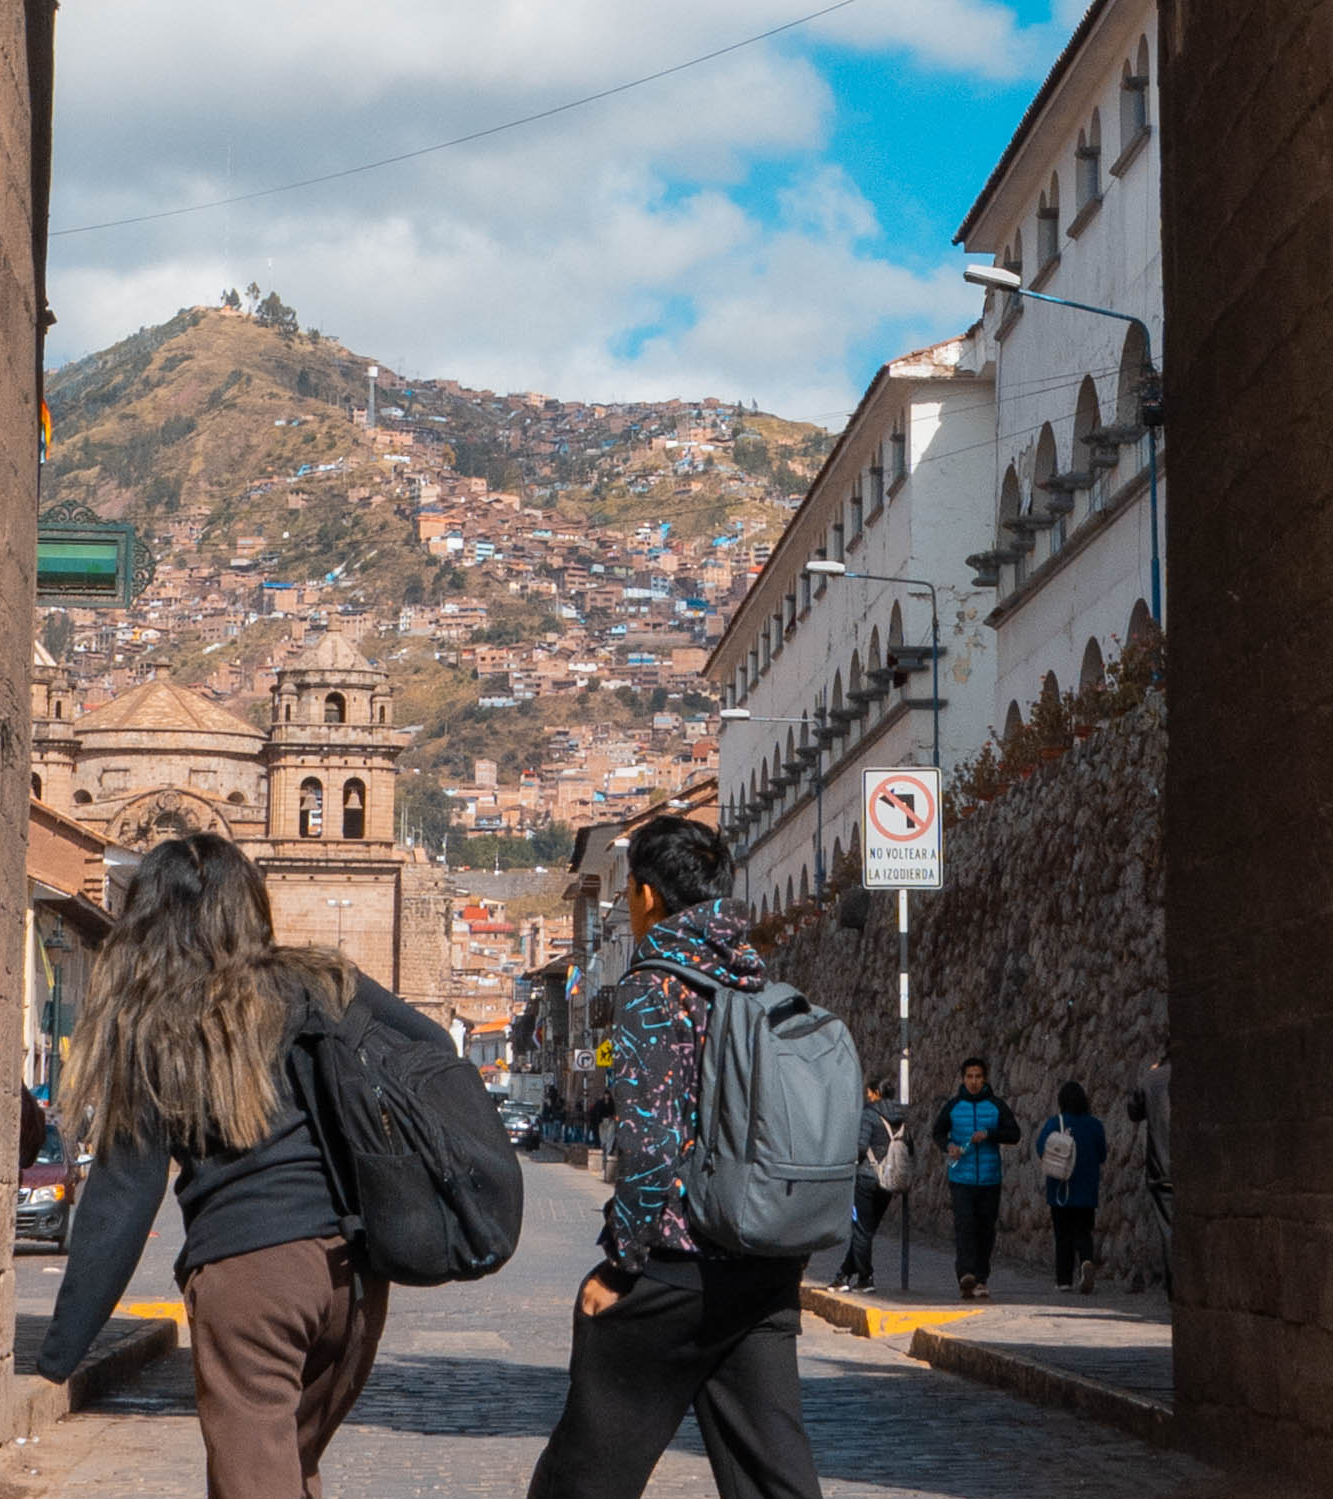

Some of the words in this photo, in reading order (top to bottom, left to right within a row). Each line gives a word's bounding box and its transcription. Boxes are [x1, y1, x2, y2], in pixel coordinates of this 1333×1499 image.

[869, 847, 883, 860] NO
[886, 847, 928, 860] VOLTEAR
[930, 847, 937, 860] A
[868, 868, 880, 880] LA
[883, 867, 935, 881] IZQUIERDA
